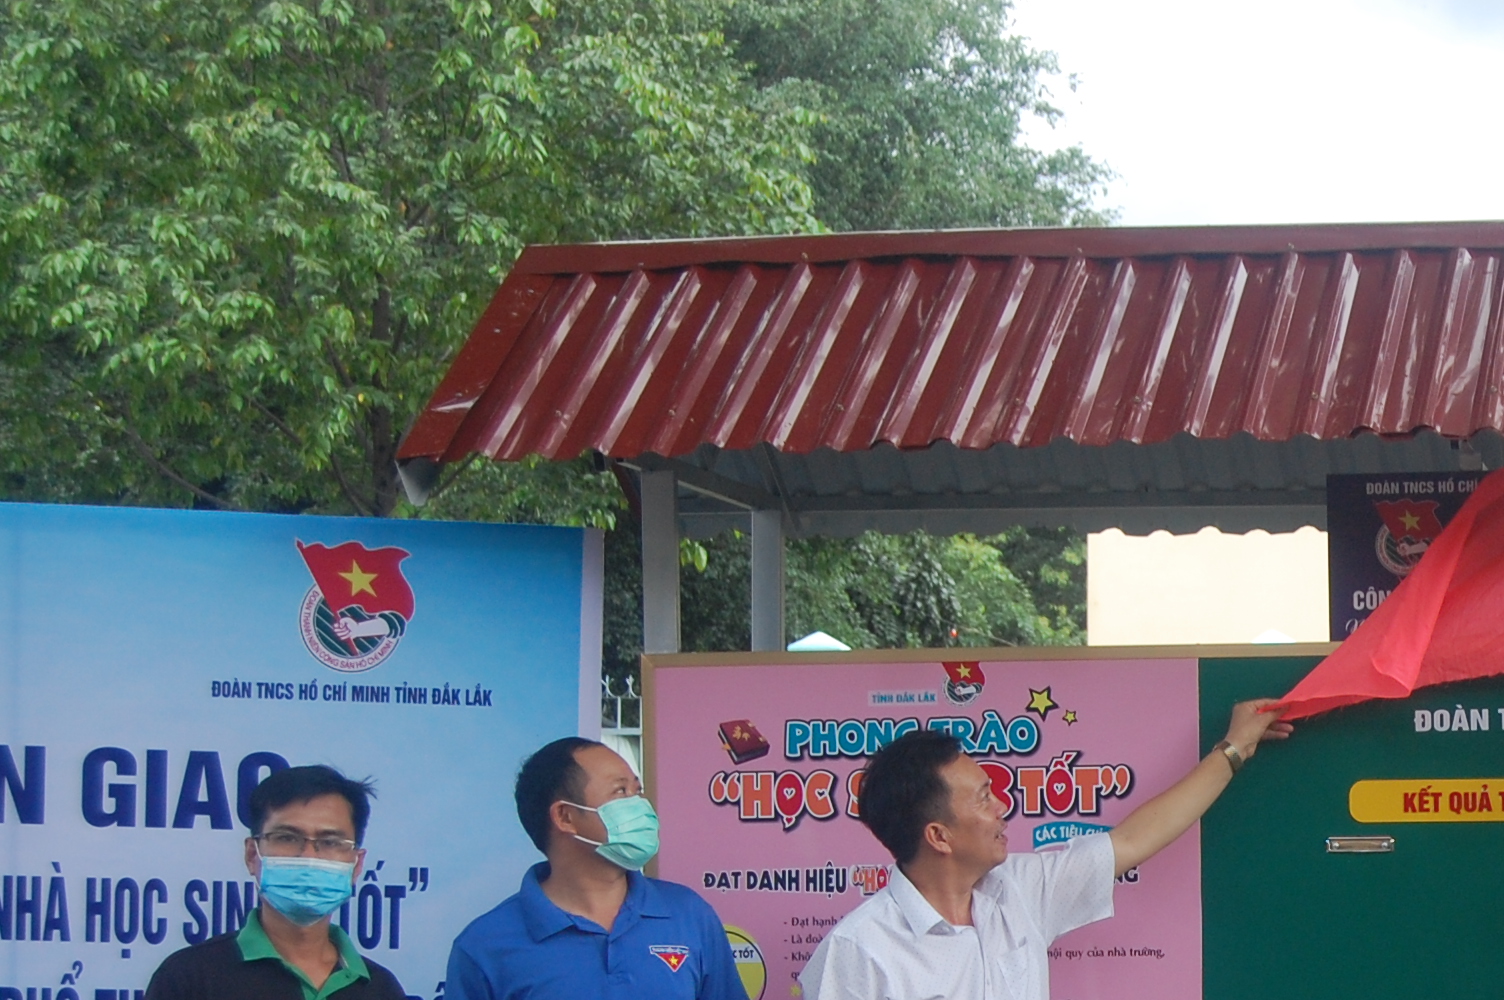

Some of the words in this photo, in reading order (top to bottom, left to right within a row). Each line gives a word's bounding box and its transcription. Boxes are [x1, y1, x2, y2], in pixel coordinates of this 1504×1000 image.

[1403, 481, 1434, 494] TNCS
[211, 678, 251, 698] ĐOÀN
[257, 682, 294, 700] TNCS
[299, 679, 318, 701] HỒ
[323, 681, 347, 702] CHÍ
[352, 685, 390, 703] MINH
[395, 681, 427, 705] TỈNH
[432, 682, 460, 706] ĐẮK
[465, 683, 492, 707] LẮK
[1414, 707, 1489, 733] ĐOÀN
[1403, 783, 1442, 814] KẾT
[1448, 783, 1493, 814] QUẢ
[1035, 825, 1057, 842] CÁC
[703, 871, 742, 893] ĐẠT
[746, 868, 800, 892] DANH
[805, 861, 847, 899] HIỆU
[85, 877, 168, 959] HỌC
[183, 879, 260, 945] SIN
[791, 916, 809, 928] Đạt
[812, 916, 838, 928] hạnh
[791, 934, 803, 944] Là
[738, 946, 754, 959] TỐT
[1065, 949, 1083, 960] quy
[1087, 946, 1104, 958] của
[1107, 947, 1127, 957] nhà
